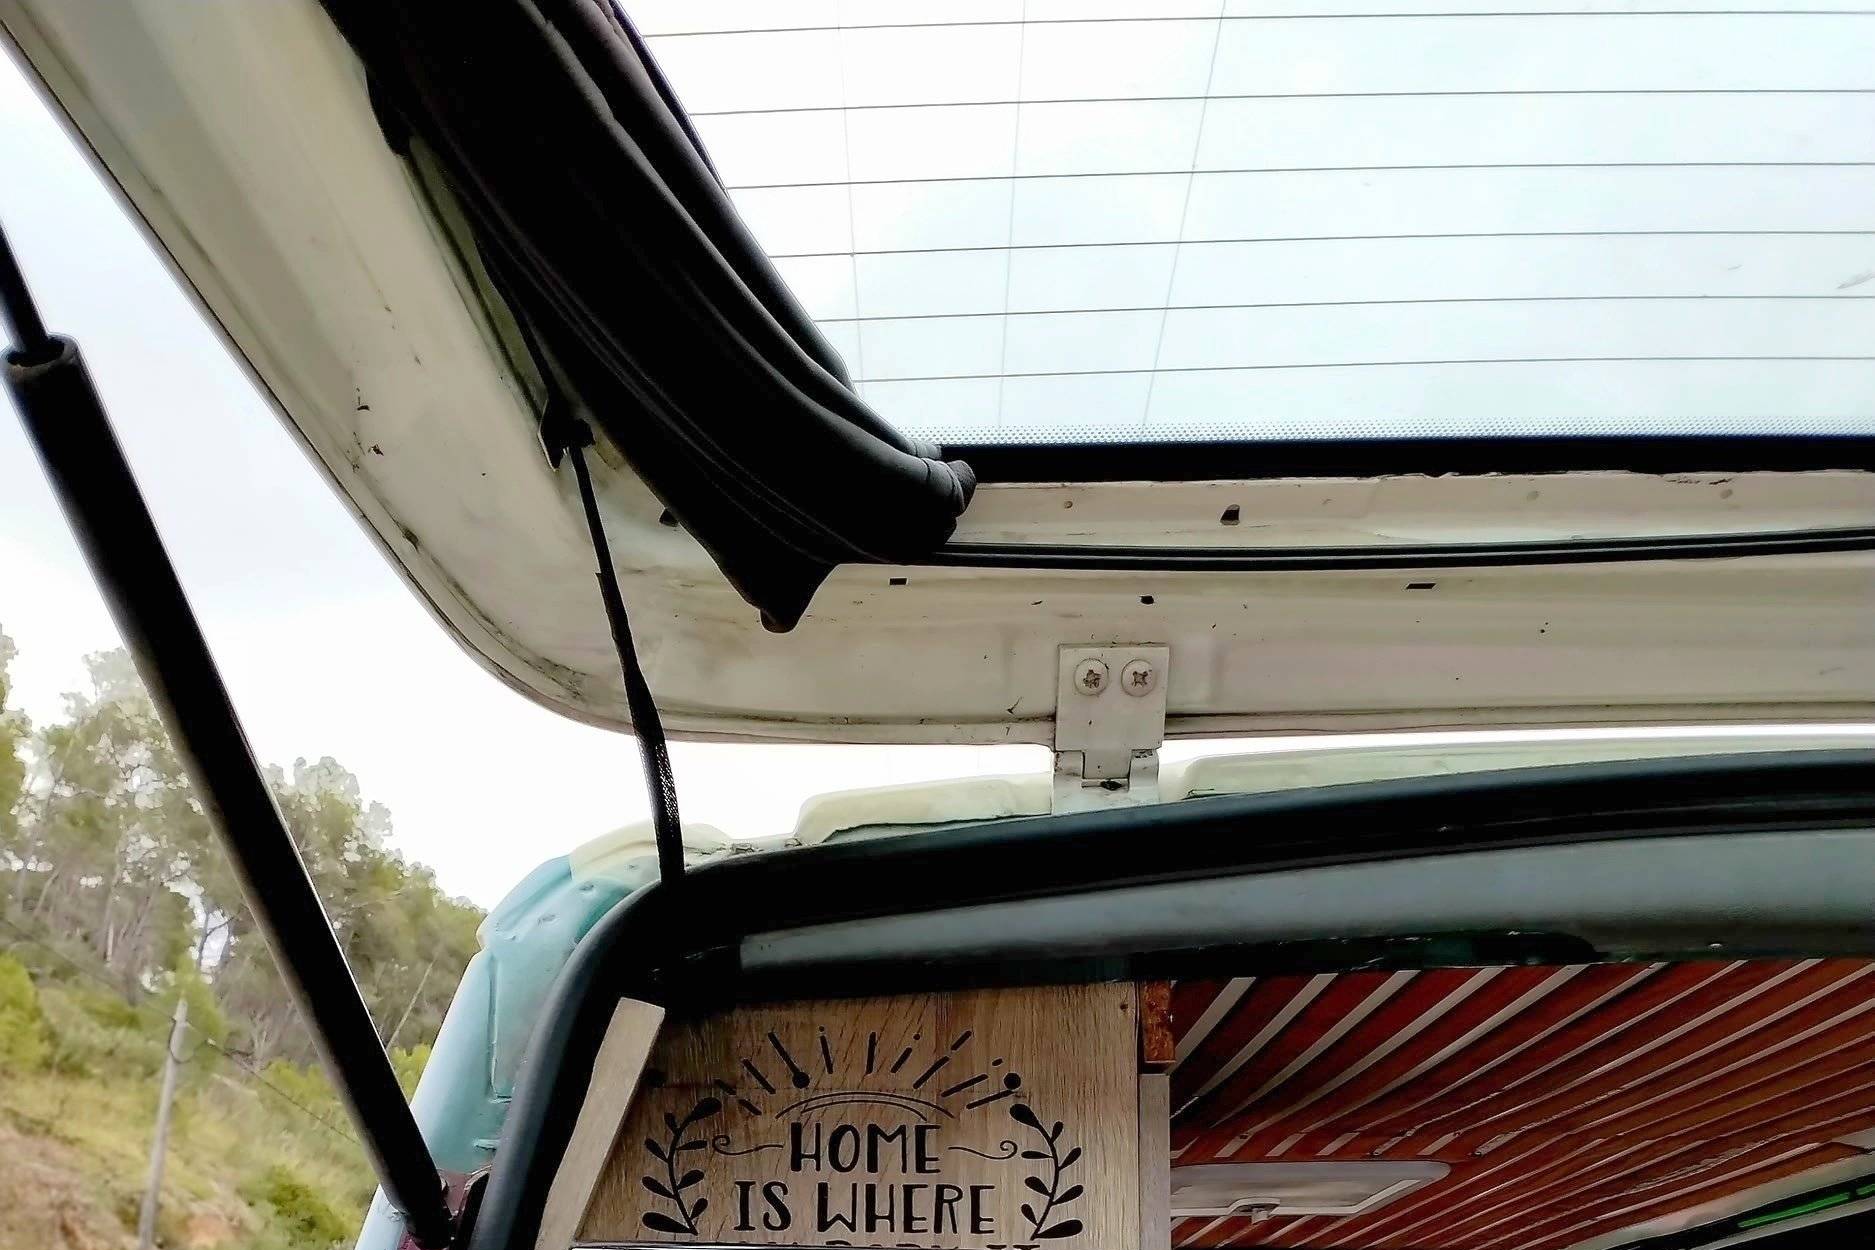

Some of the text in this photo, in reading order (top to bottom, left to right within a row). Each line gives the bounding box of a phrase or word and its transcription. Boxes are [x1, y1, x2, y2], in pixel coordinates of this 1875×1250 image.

[790, 1121, 941, 1174] HOME
[733, 1180, 996, 1235] IS WHERE
